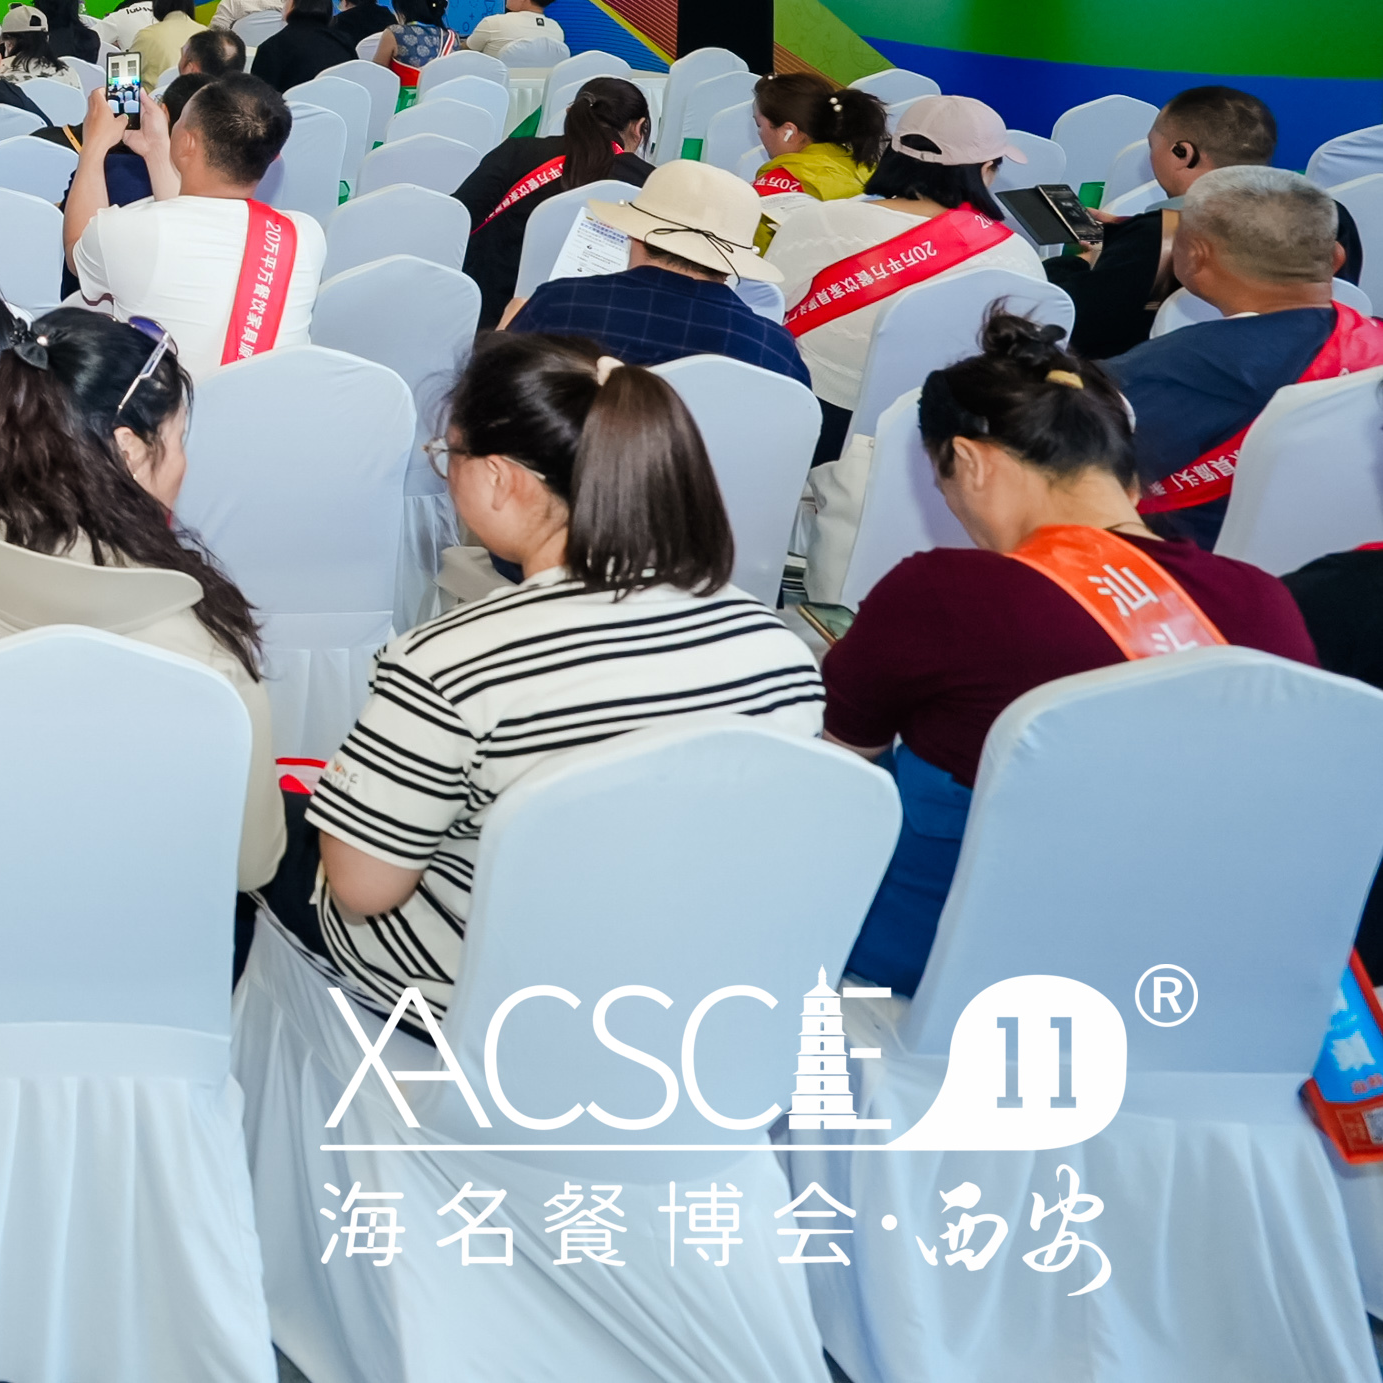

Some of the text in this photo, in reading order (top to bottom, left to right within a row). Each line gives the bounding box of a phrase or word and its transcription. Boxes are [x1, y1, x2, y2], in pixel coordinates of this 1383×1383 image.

[236, 219, 282, 361] 20万平方餐饮家具源
